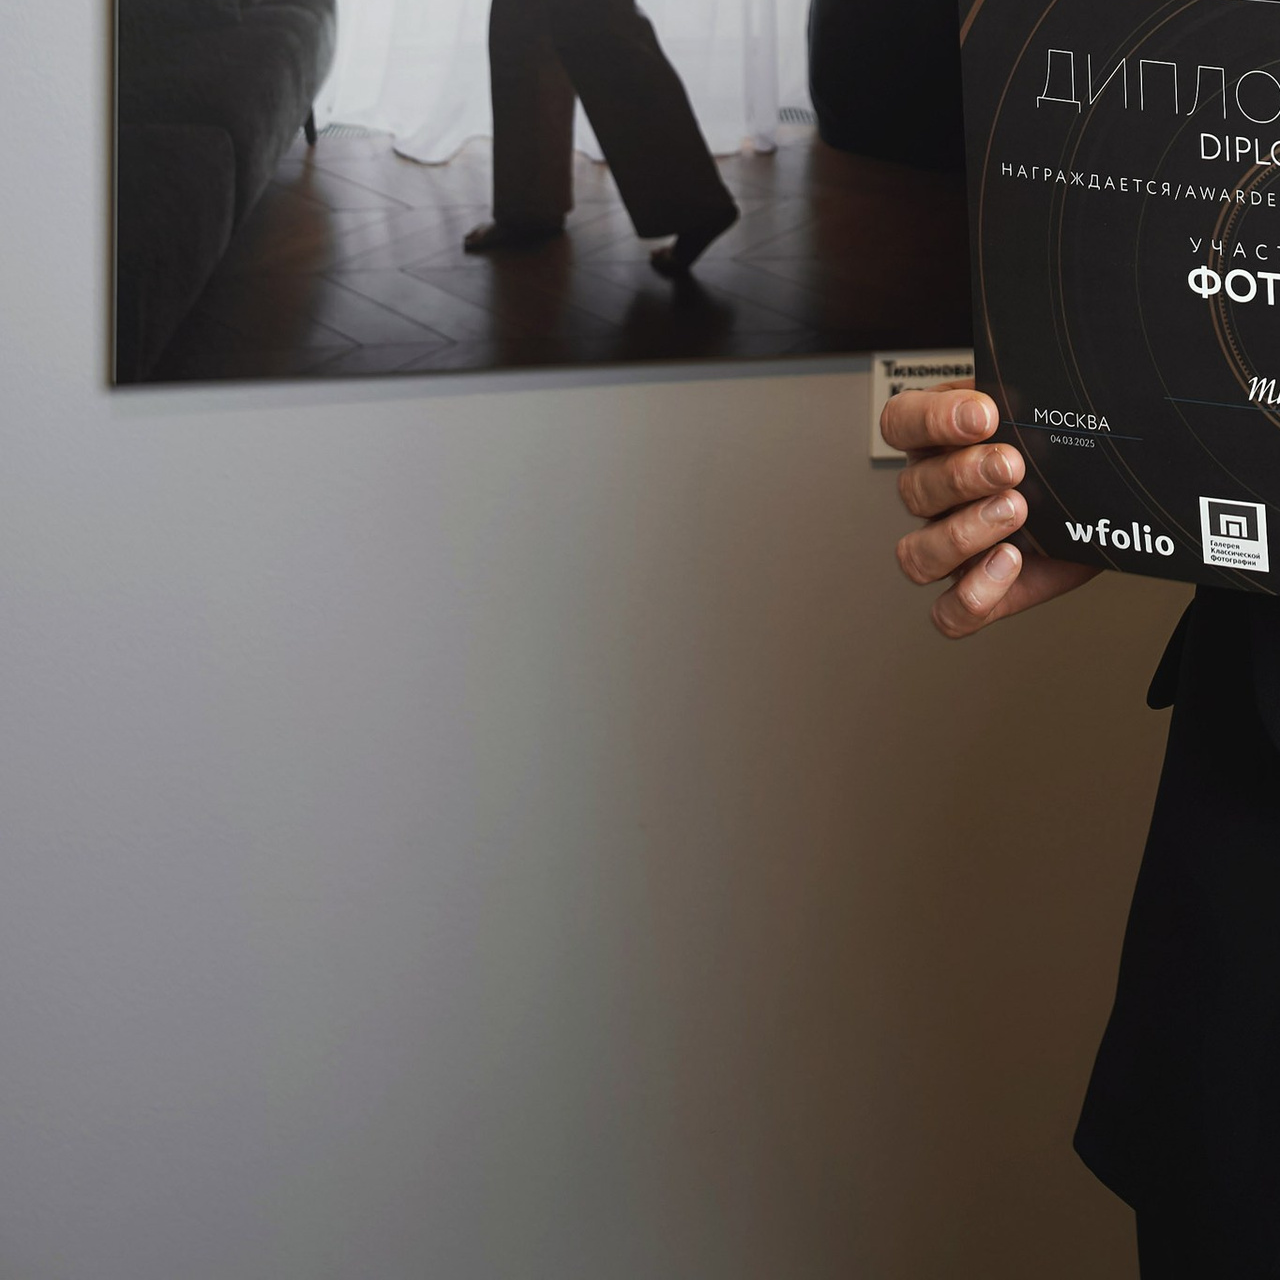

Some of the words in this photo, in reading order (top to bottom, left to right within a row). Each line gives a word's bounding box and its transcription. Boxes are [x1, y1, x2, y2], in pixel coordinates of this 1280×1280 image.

[1033, 407, 1111, 432] МОСКВА
[1050, 434, 1095, 449] 04.03.2025
[1065, 518, 1175, 557] wfolio
[1210, 540, 1240, 550] Галерея
[1210, 547, 1261, 560] Классической
